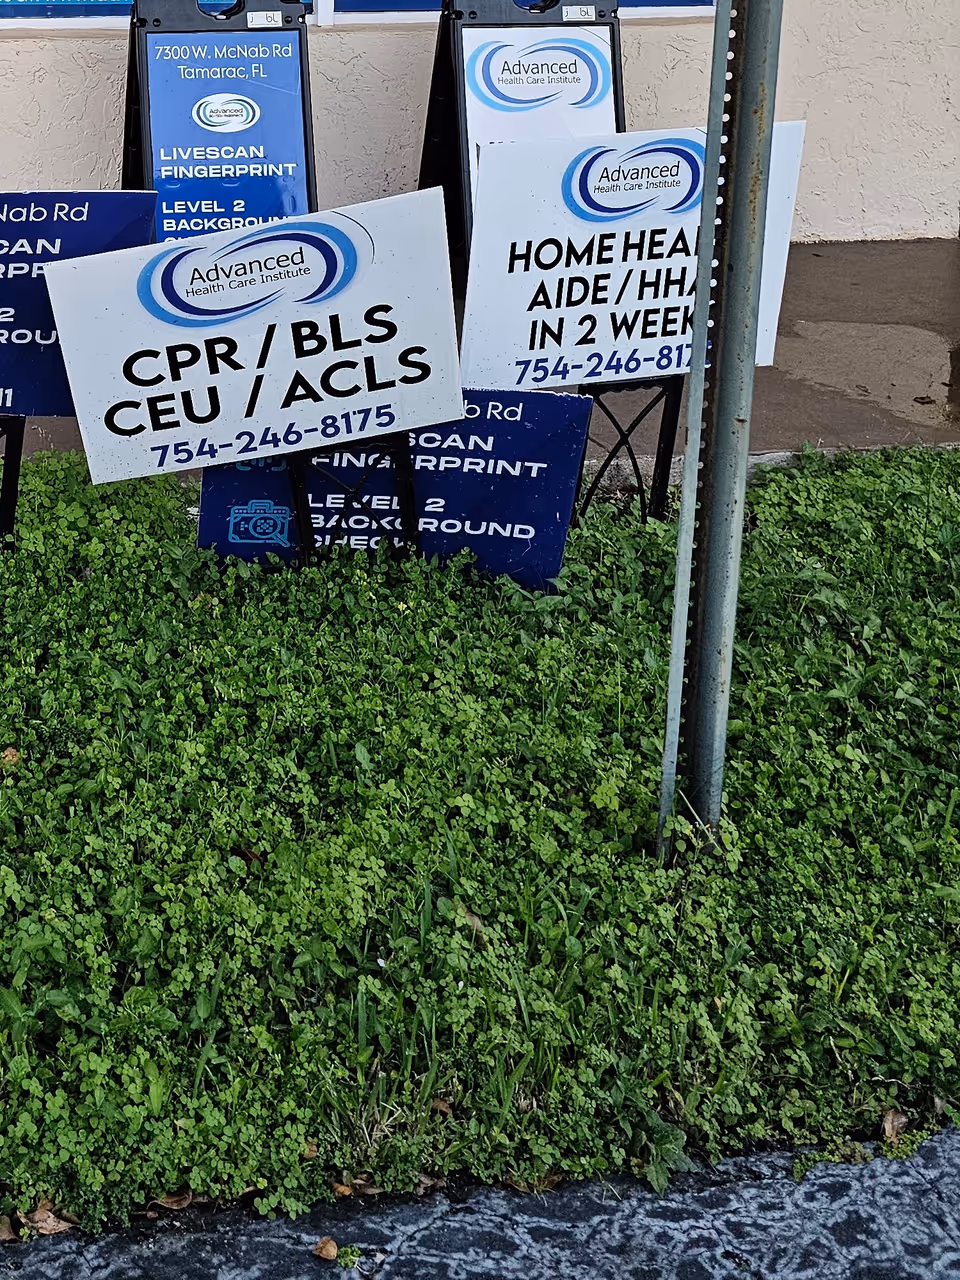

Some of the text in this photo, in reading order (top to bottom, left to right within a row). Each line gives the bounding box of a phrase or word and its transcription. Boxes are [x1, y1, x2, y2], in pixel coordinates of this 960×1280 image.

[154, 43, 292, 60] 7300 W. McNab Rd
[177, 63, 267, 80] Tamarac, FL
[501, 59, 578, 76] Advanced
[497, 75, 581, 86] Health Care Institute
[160, 146, 264, 161] LIVESCAN
[161, 163, 297, 179] FINGERPRINT
[598, 160, 680, 182] Advanced
[593, 178, 681, 195] Health Care Institute
[52, 201, 90, 222] Rd
[162, 200, 246, 214] LEVEL 2
[507, 233, 617, 274] HOME
[189, 246, 306, 286] Advanced
[185, 265, 312, 298] Health Care Institute
[527, 273, 611, 312] AIDE
[528, 318, 564, 351] IN
[575, 314, 598, 346] 2
[122, 304, 399, 388] CPR BLS
[104, 346, 432, 437] CEU ACLS
[486, 402, 524, 421] Rd
[150, 403, 396, 468] 754-246-8175
[424, 498, 446, 512] 2
